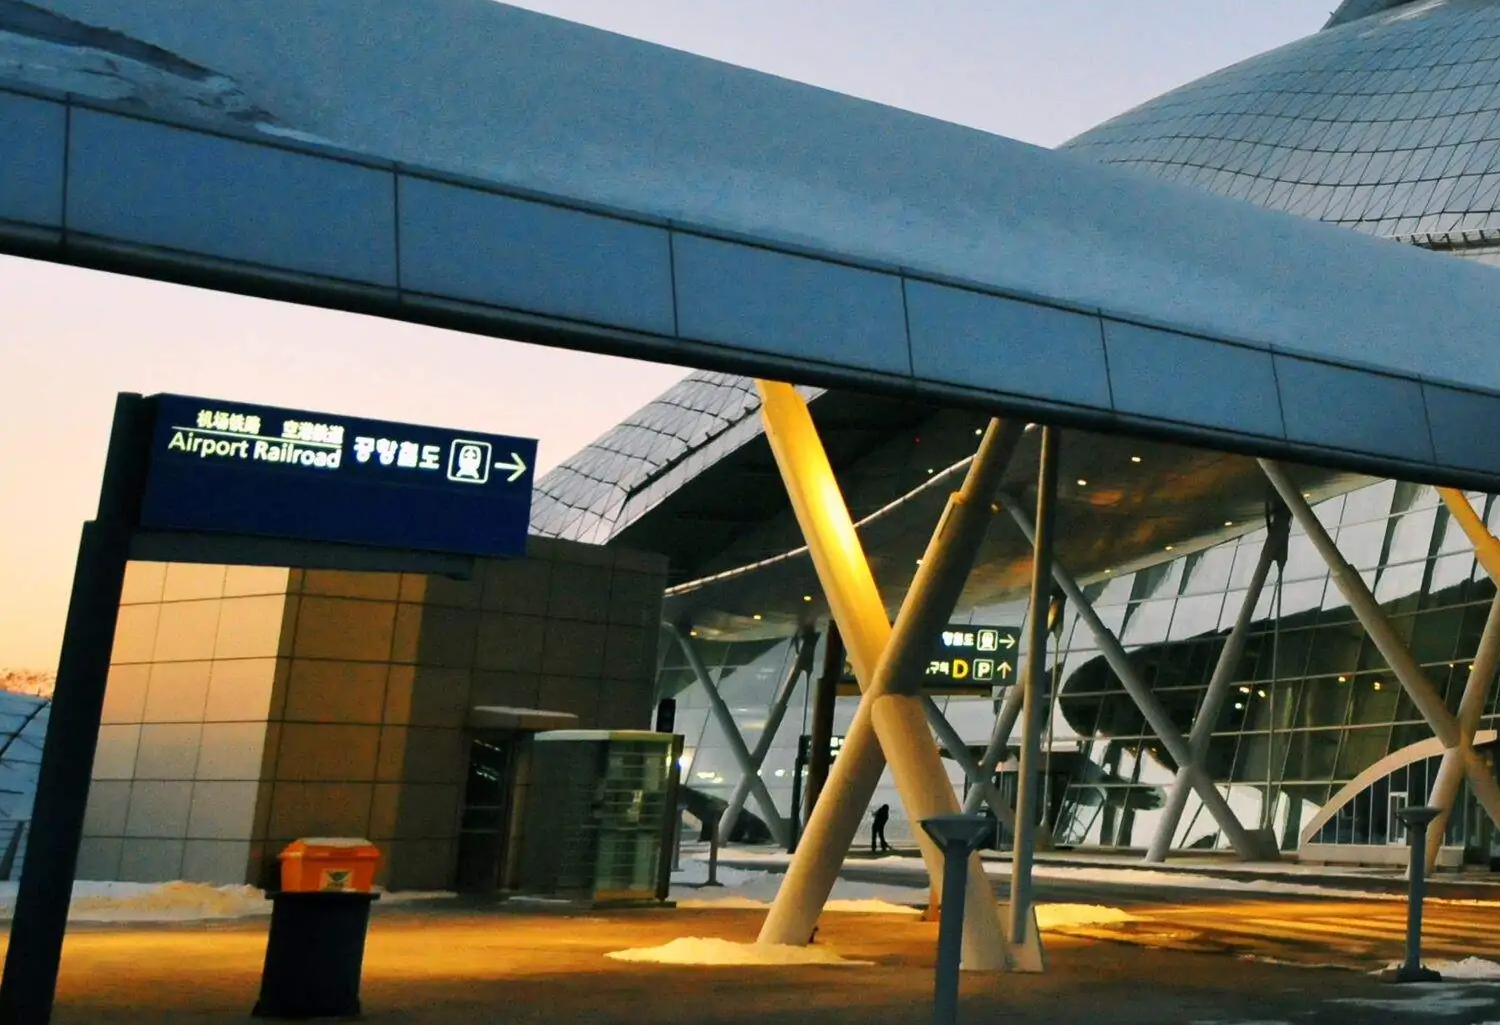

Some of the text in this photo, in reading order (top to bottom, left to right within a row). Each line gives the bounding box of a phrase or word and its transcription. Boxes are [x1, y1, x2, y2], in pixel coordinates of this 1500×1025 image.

[168, 431, 342, 469] Airport Railroad
[952, 658, 969, 679] D
